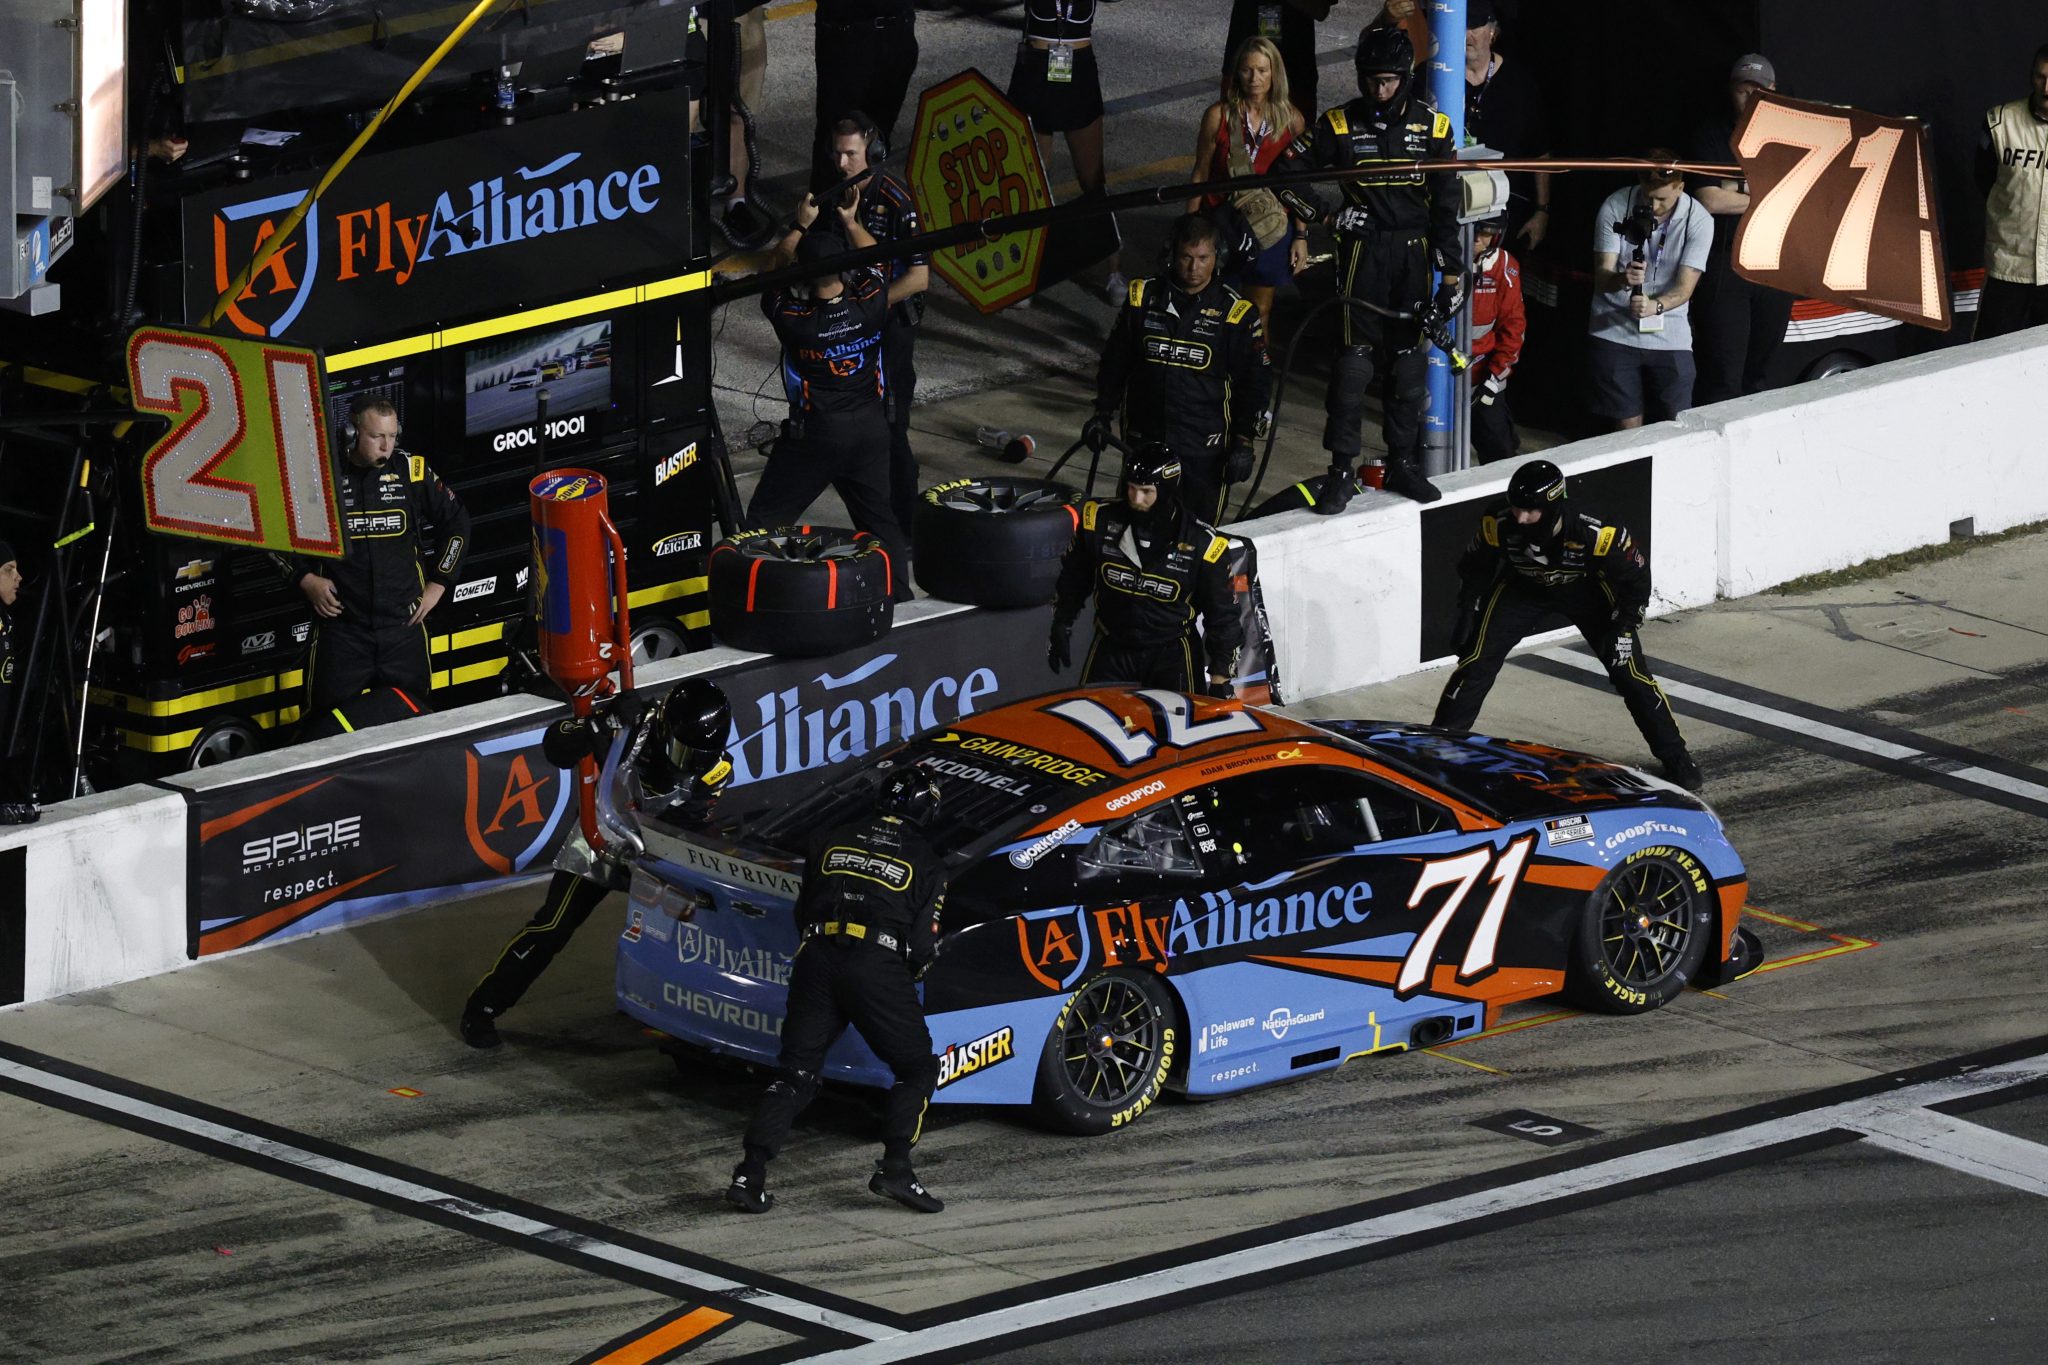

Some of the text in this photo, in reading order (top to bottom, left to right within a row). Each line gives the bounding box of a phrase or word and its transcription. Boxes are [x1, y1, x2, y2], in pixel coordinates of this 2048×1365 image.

[938, 127, 1008, 200] STOP
[2003, 147, 2048, 169] OFFI
[1738, 100, 1904, 291] 71
[335, 152, 661, 286] FlyAlliance
[132, 330, 342, 556] 21
[556, 477, 588, 500] SUNOC
[656, 533, 702, 557] ZEIGLER
[175, 579, 215, 593] CHEVROLET
[516, 566, 528, 584] WI
[456, 580, 495, 599] COMETIC
[175, 617, 216, 638] BOWLING
[178, 605, 194, 623] GO
[294, 624, 309, 634] LINC
[725, 654, 998, 788] Alliance
[1046, 689, 1265, 764] 71
[1201, 753, 1277, 776] ADAM BROOKHART
[1105, 780, 1166, 812] GROUP1001
[1558, 815, 1582, 828] NASCAR
[1566, 827, 1586, 837] SERIES
[1605, 821, 1687, 849] GOODYEAR
[1016, 819, 1081, 864] WORKFORCE
[242, 840, 360, 874] MOTORSPORTS
[688, 848, 802, 893] FLY PRIVAT
[829, 852, 905, 880] SPIRE
[1626, 845, 1707, 894] GOODYEAR
[264, 870, 339, 902] respect.
[1093, 872, 1374, 974] FlyAlliance
[1397, 834, 1532, 993] 71
[683, 929, 697, 953] A
[1038, 923, 1077, 967] A
[704, 934, 792, 986] FlyAllia
[1604, 976, 1646, 1005] EAGLE
[664, 982, 785, 1036] CHEVROL
[1262, 1008, 1324, 1031] NationsGuard
[1211, 1017, 1255, 1036] Delaware
[1211, 1035, 1228, 1049] Life
[1111, 1028, 1175, 1127] GOODYEAR
[1212, 1061, 1260, 1083] respect.
[1508, 1119, 1562, 1136] 5
